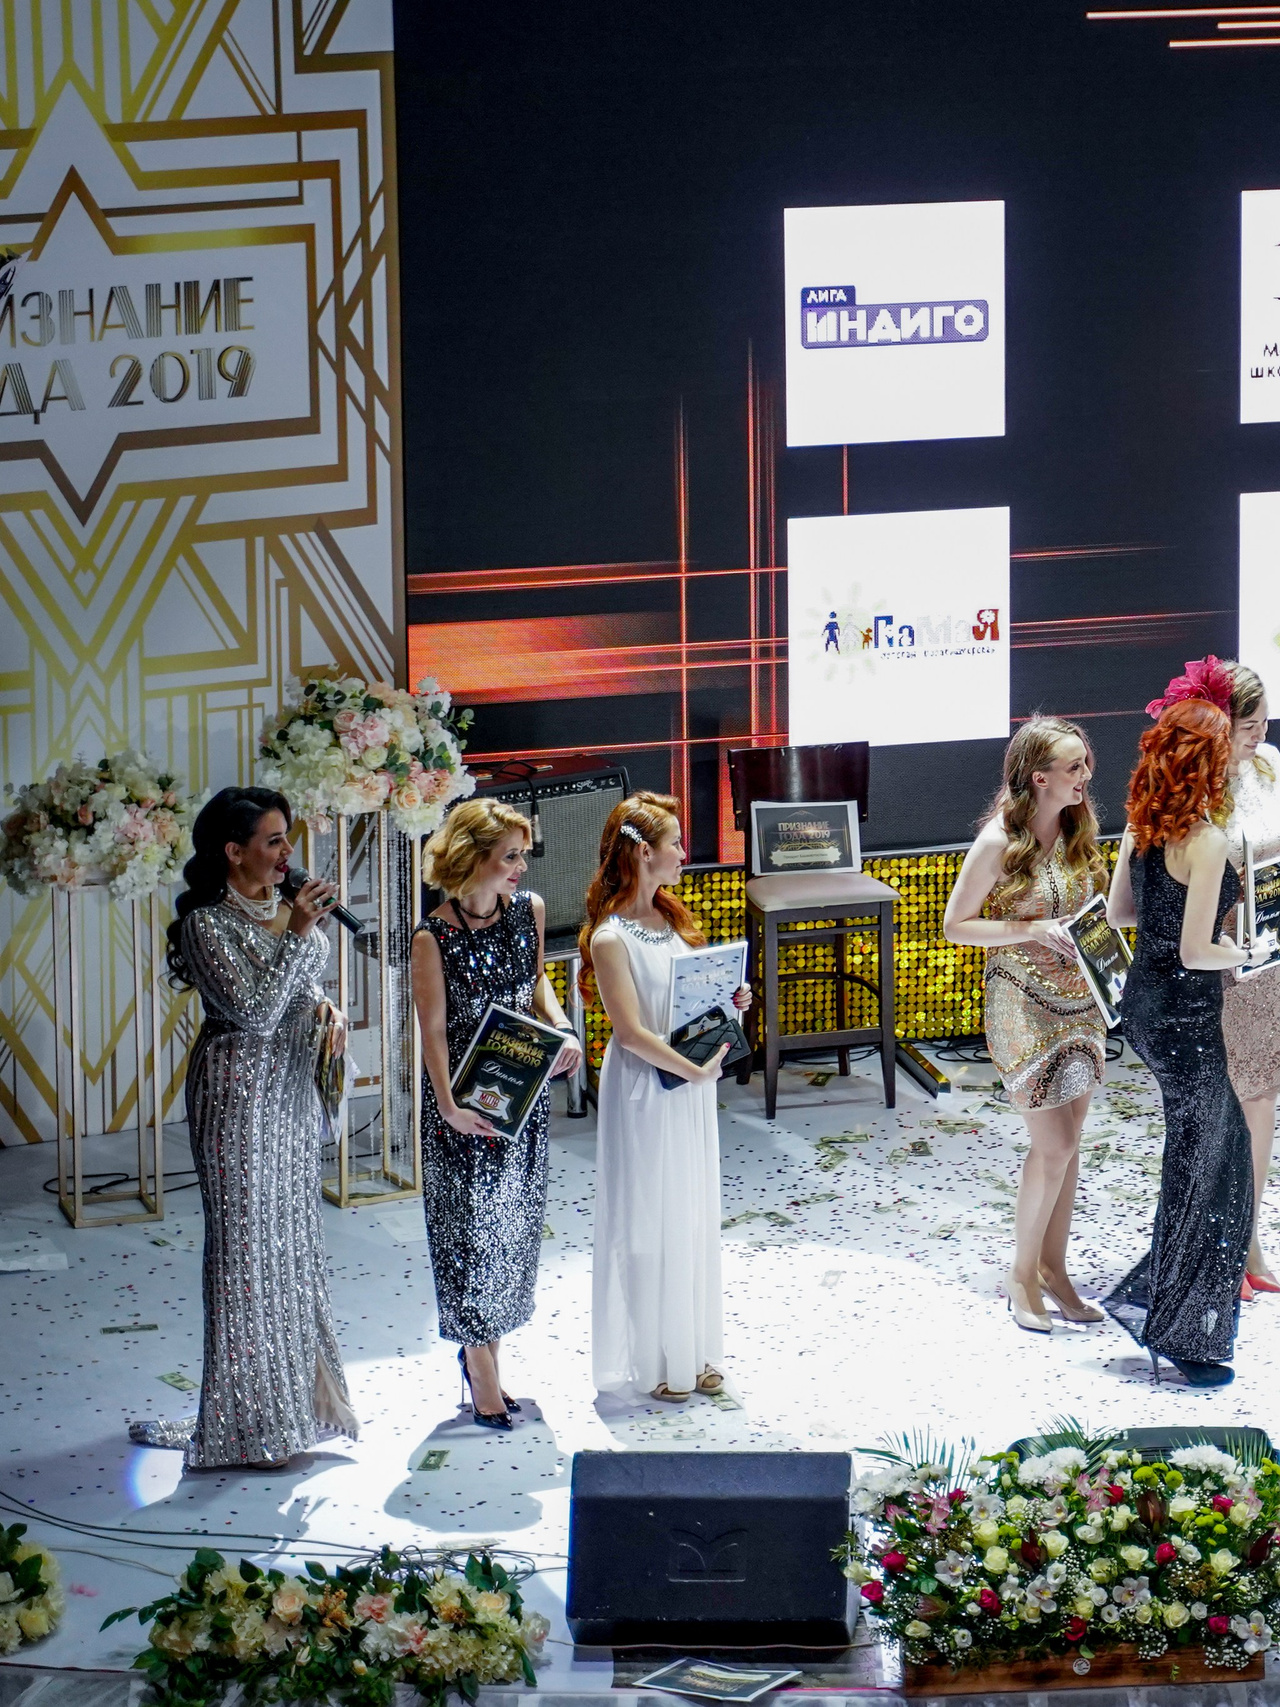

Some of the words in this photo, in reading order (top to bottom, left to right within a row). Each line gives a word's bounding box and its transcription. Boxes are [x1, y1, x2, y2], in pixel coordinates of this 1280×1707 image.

[806, 289, 848, 304] ЛИГА
[807, 305, 985, 343] ИНДИГО
[107, 345, 257, 408] 2019
[778, 821, 830, 831] ПРИЗНАНИЕ
[486, 1038, 514, 1058] ГОДА
[516, 1052, 541, 1067] 2019
